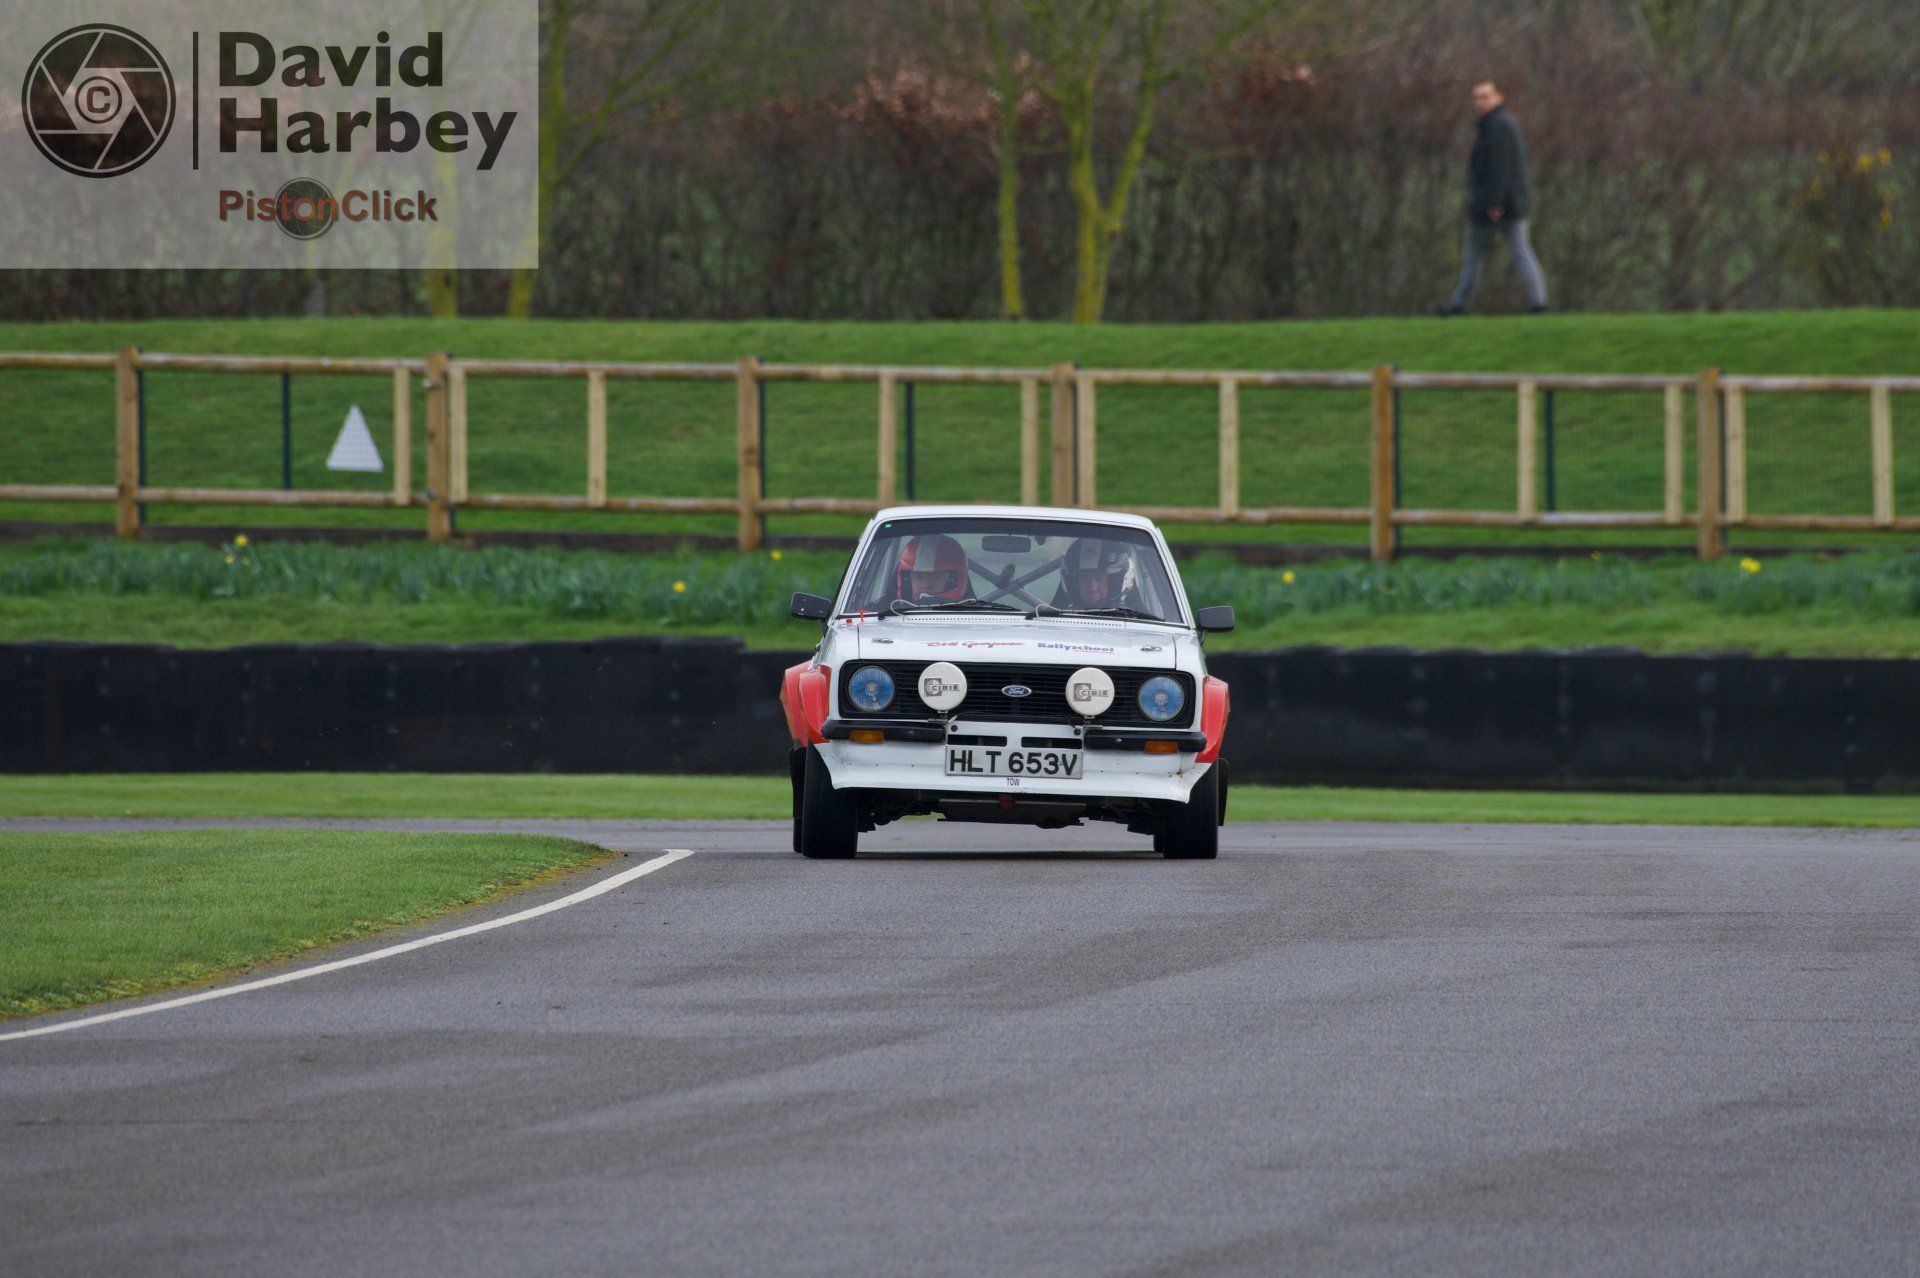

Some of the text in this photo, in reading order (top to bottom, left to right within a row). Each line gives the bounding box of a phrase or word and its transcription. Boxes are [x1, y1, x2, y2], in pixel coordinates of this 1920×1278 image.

[950, 749, 1078, 776] HLT 653V
[1006, 777, 1021, 786] TOW
